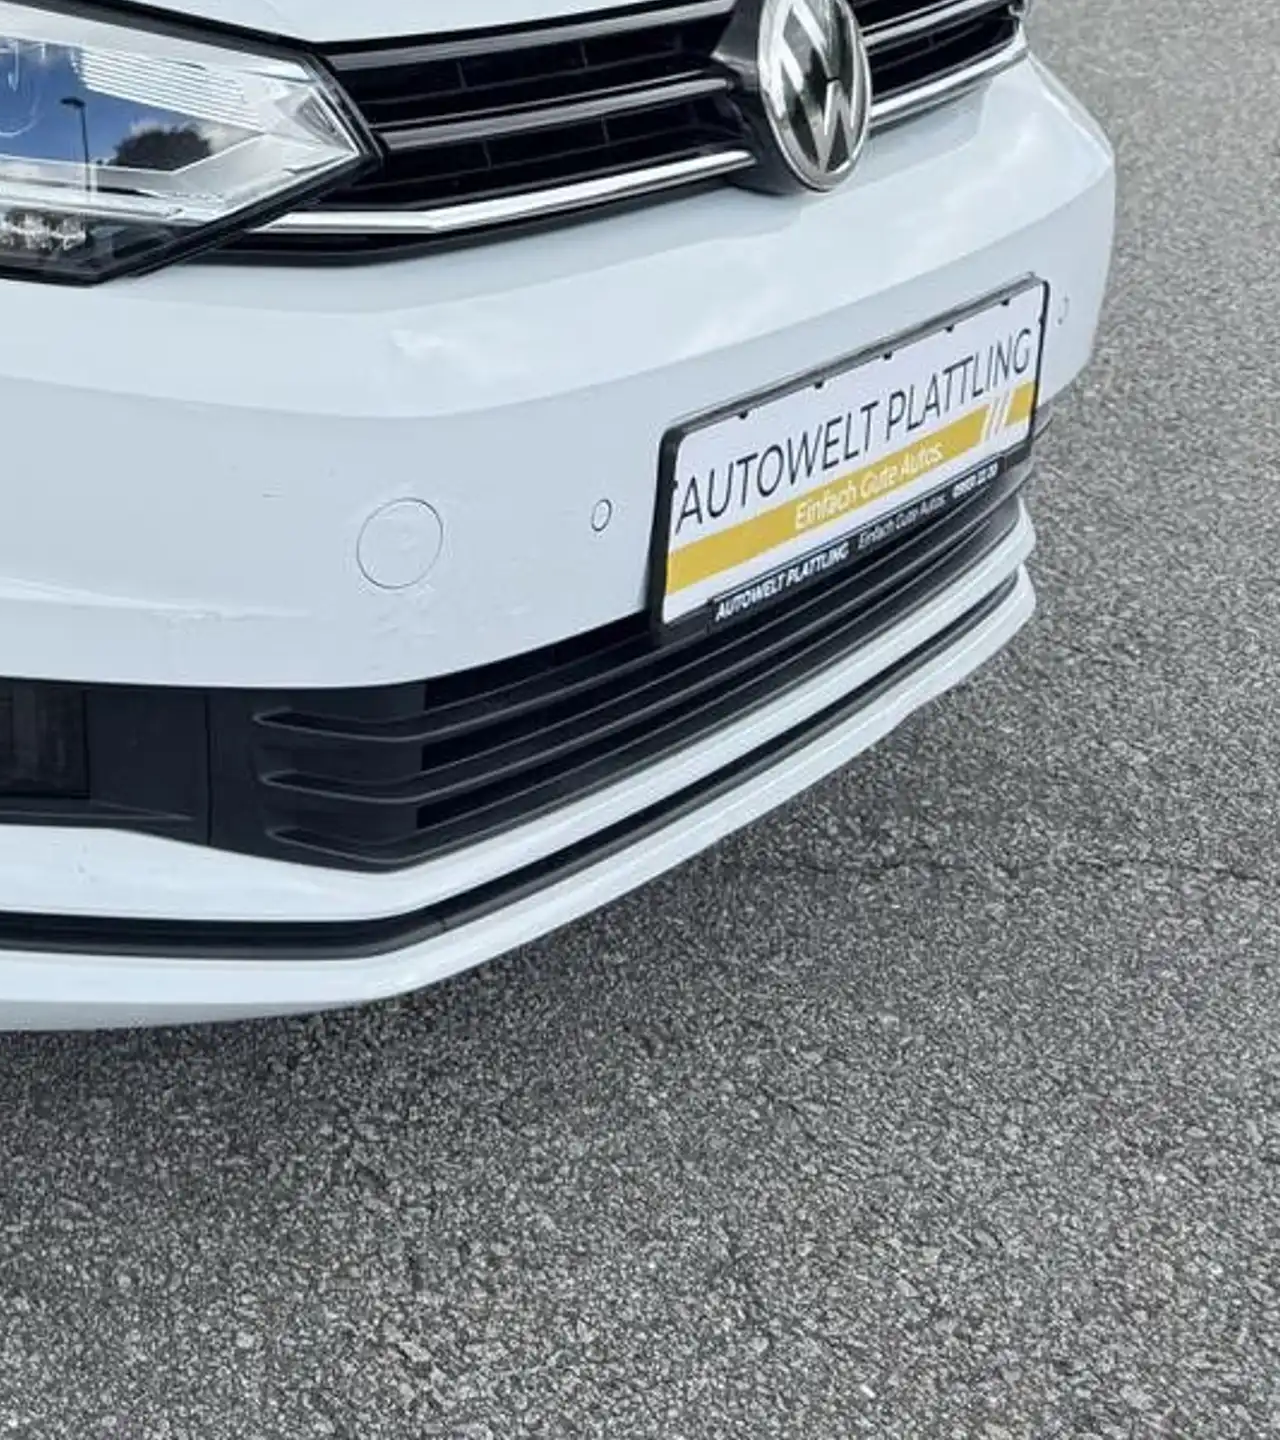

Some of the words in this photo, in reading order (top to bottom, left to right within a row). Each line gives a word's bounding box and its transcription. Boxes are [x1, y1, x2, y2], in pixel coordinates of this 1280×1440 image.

[675, 401, 879, 535] AUTOWELT
[885, 327, 1032, 442] PLATTLING
[795, 479, 858, 530] Einfach
[859, 461, 899, 500] Gute
[900, 441, 945, 477] Autos
[714, 570, 787, 622] AUTOWELT
[786, 542, 850, 590] PLATTLING
